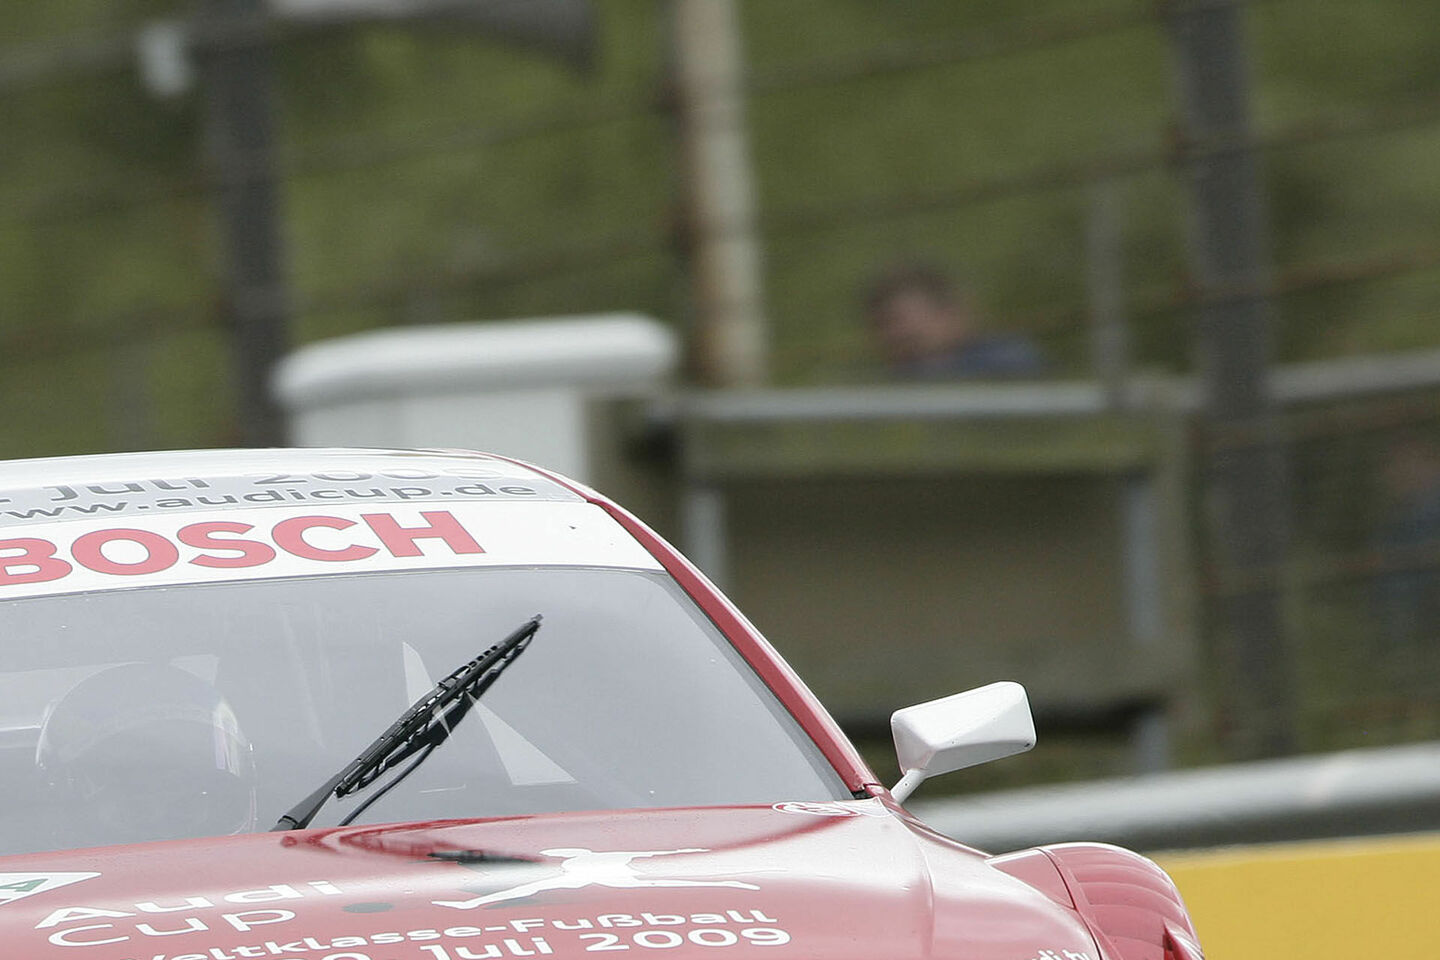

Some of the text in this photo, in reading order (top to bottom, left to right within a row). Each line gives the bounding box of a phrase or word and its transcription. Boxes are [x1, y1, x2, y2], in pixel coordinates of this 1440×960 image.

[35, 880, 346, 930] Audi
[48, 908, 296, 947] Cup
[579, 928, 792, 952] 2009
